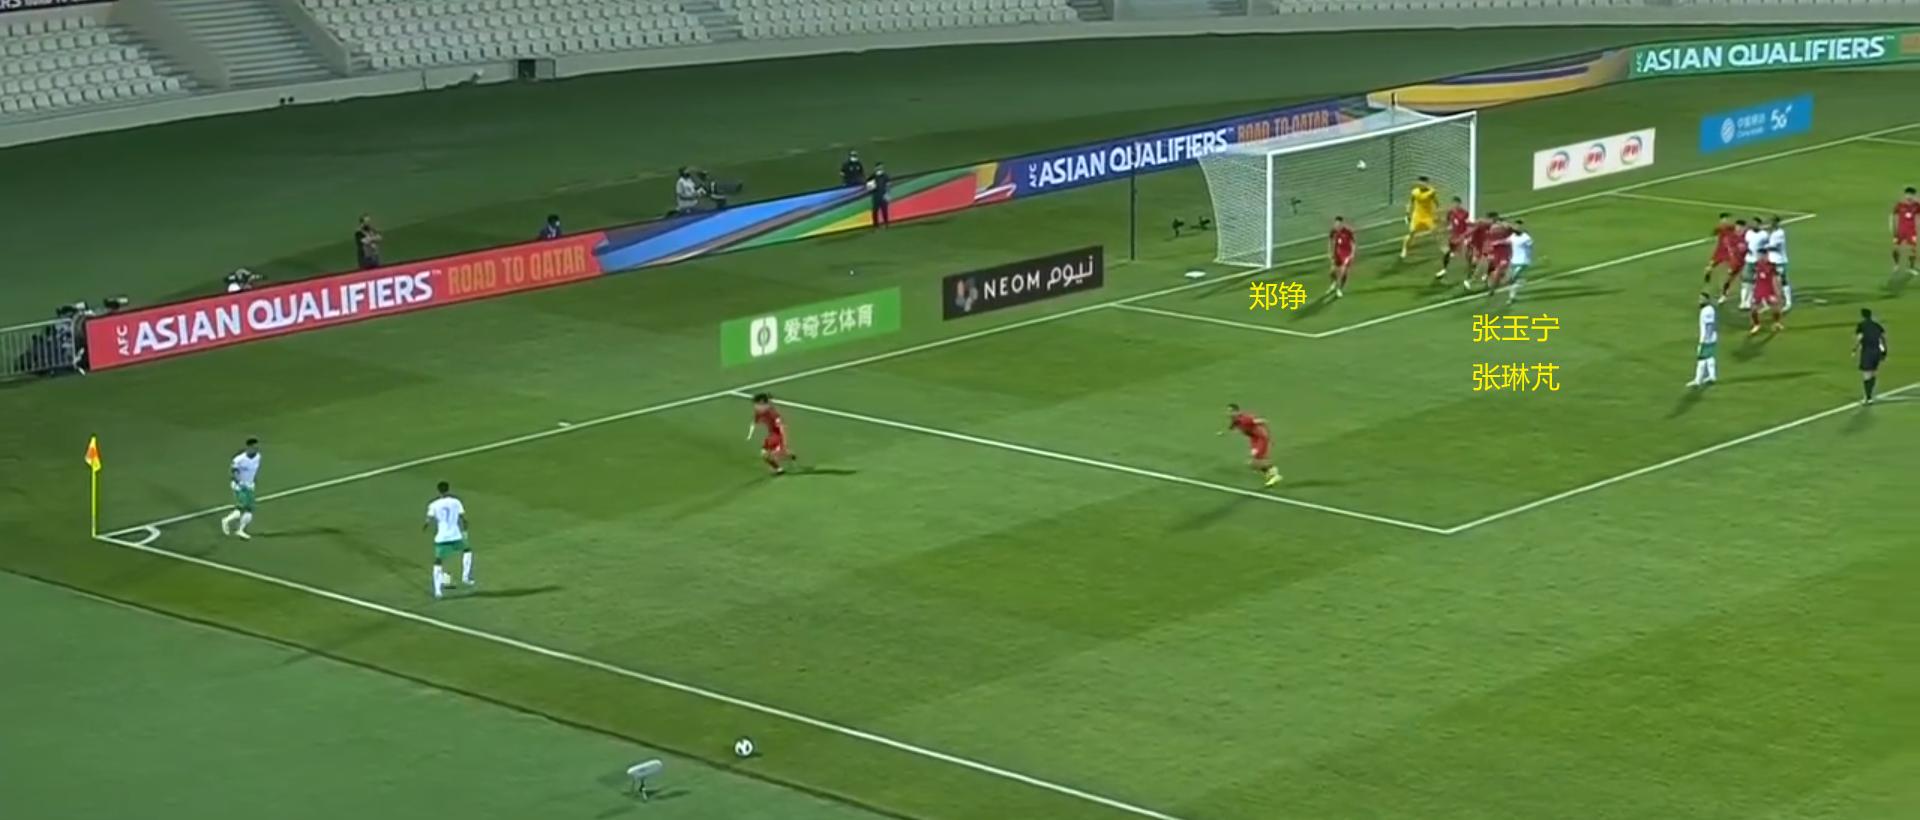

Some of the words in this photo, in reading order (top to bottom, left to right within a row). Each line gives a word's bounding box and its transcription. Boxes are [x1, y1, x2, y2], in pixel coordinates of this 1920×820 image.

[1644, 46, 1722, 73] ASIAN
[1039, 149, 1105, 188] ASIAN
[984, 270, 1040, 300] NEOM
[1047, 255, 1093, 290] نيوم
[117, 324, 130, 356] AFC
[133, 304, 241, 355] ASIAN
[449, 259, 496, 294] ROAD
[502, 256, 524, 284] TO
[532, 245, 586, 281] QATAR
[783, 303, 873, 344] 爱奇艺体育
